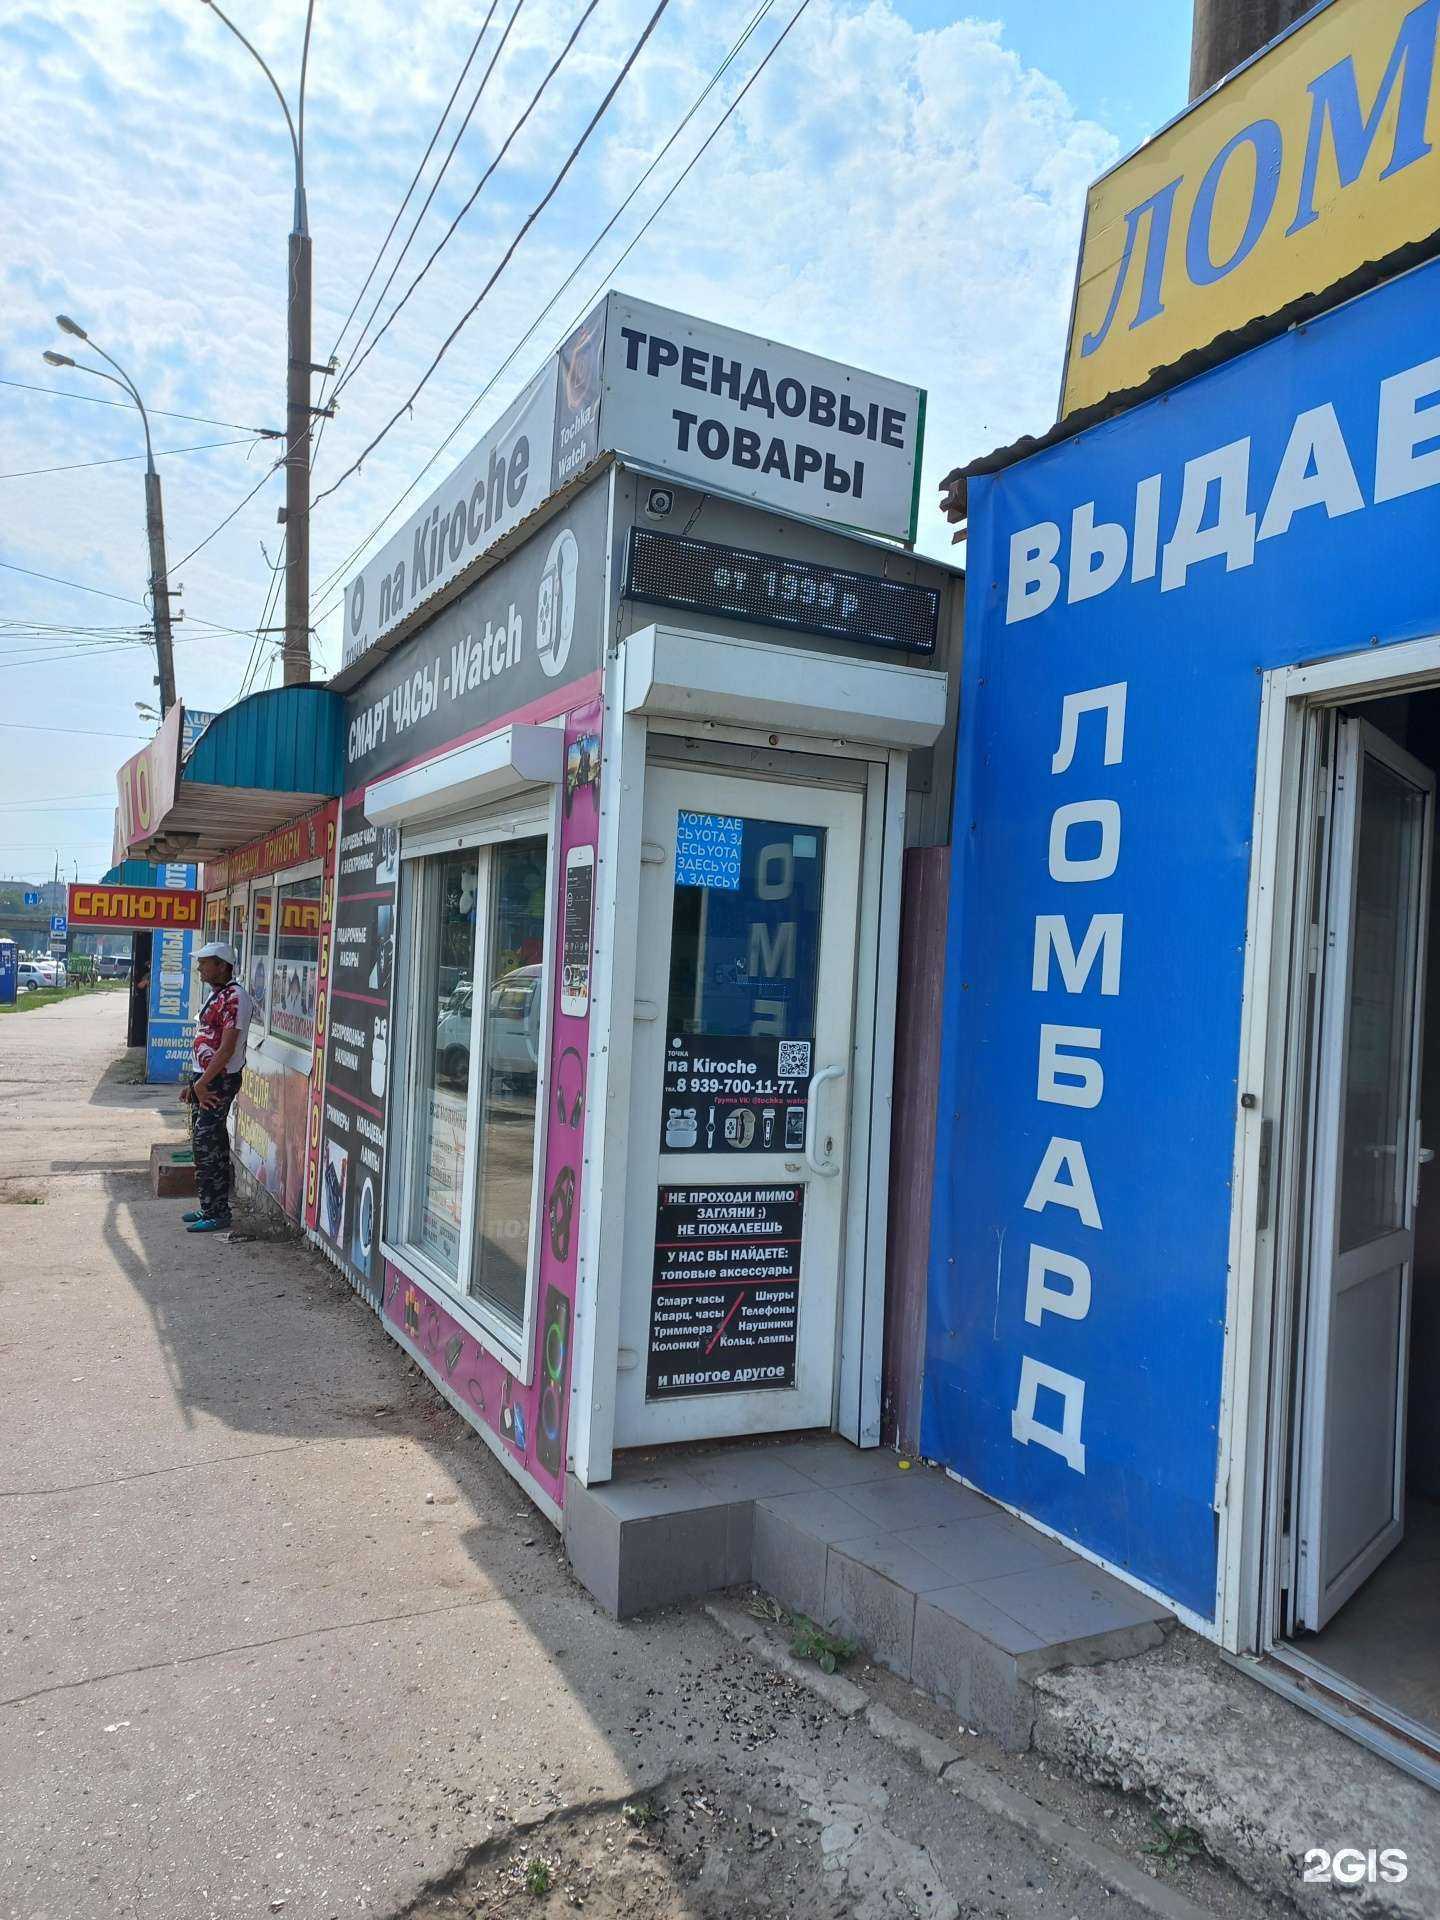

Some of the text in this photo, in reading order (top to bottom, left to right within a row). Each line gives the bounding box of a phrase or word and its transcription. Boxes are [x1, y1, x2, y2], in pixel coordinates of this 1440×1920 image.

[1080, 0, 1440, 358] ЛОМ
[620, 327, 907, 449] ТРЕНДОВЫЕ
[558, 440, 587, 479] Watch
[672, 408, 865, 499] ТОВАРЫ
[1006, 358, 1440, 625] ВЫДАЕ
[378, 434, 529, 628] na Kiroche
[348, 694, 391, 763] СМАРТ
[392, 657, 440, 735] ЧАСЫ
[680, 812, 713, 827] YOTA
[73, 890, 197, 921] САЛЮТЫ
[667, 1058, 757, 1074] na Kiroche
[1011, 681, 1128, 1475] ЛОМБАРД
[690, 1191, 751, 1204] ПРОХОДИ
[697, 1207, 755, 1219] ЗАГЛЯНИ
[677, 1222, 783, 1236] НЕ ПОЖАЛЕЕШЬ
[667, 1246, 789, 1263] У НАС ВЫ НАЙДЕТЕ:
[661, 1265, 793, 1280] топовые аксессуары
[657, 1295, 725, 1309] Смарт часы
[755, 1291, 794, 1303] Шнуры
[695, 1310, 725, 1320] часы
[741, 1305, 795, 1317] Телефоны
[654, 1324, 713, 1338] Триммера
[738, 1320, 794, 1332] Наушники
[651, 1340, 700, 1352] Колонки
[757, 1334, 794, 1344] лампы
[658, 1366, 785, 1386] и многое другое
